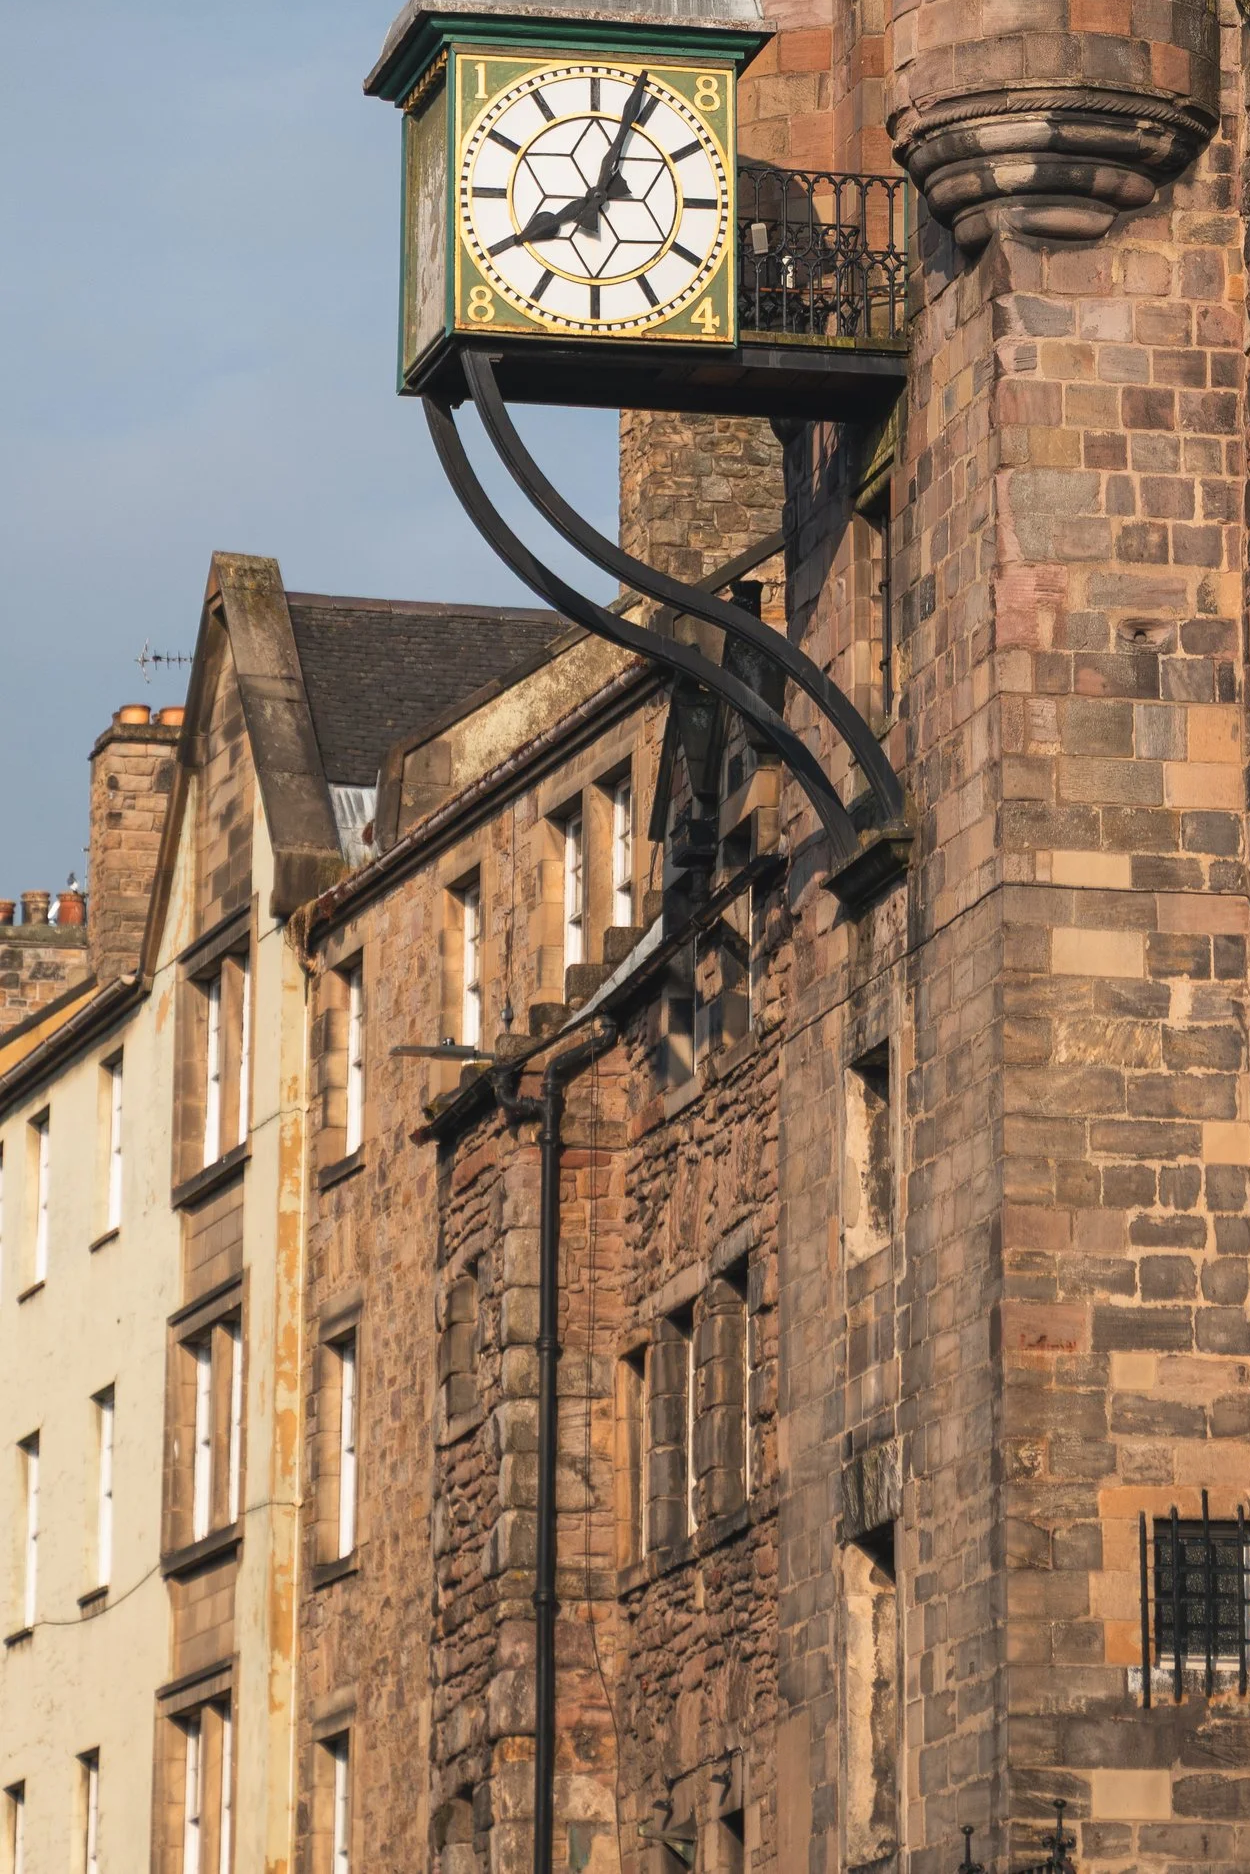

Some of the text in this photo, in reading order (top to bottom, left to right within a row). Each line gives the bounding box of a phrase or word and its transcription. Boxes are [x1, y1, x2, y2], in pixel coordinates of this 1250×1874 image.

[475, 63, 489, 99] 1
[693, 76, 720, 111] 8
[467, 286, 494, 323] 8
[690, 297, 719, 333] 4
